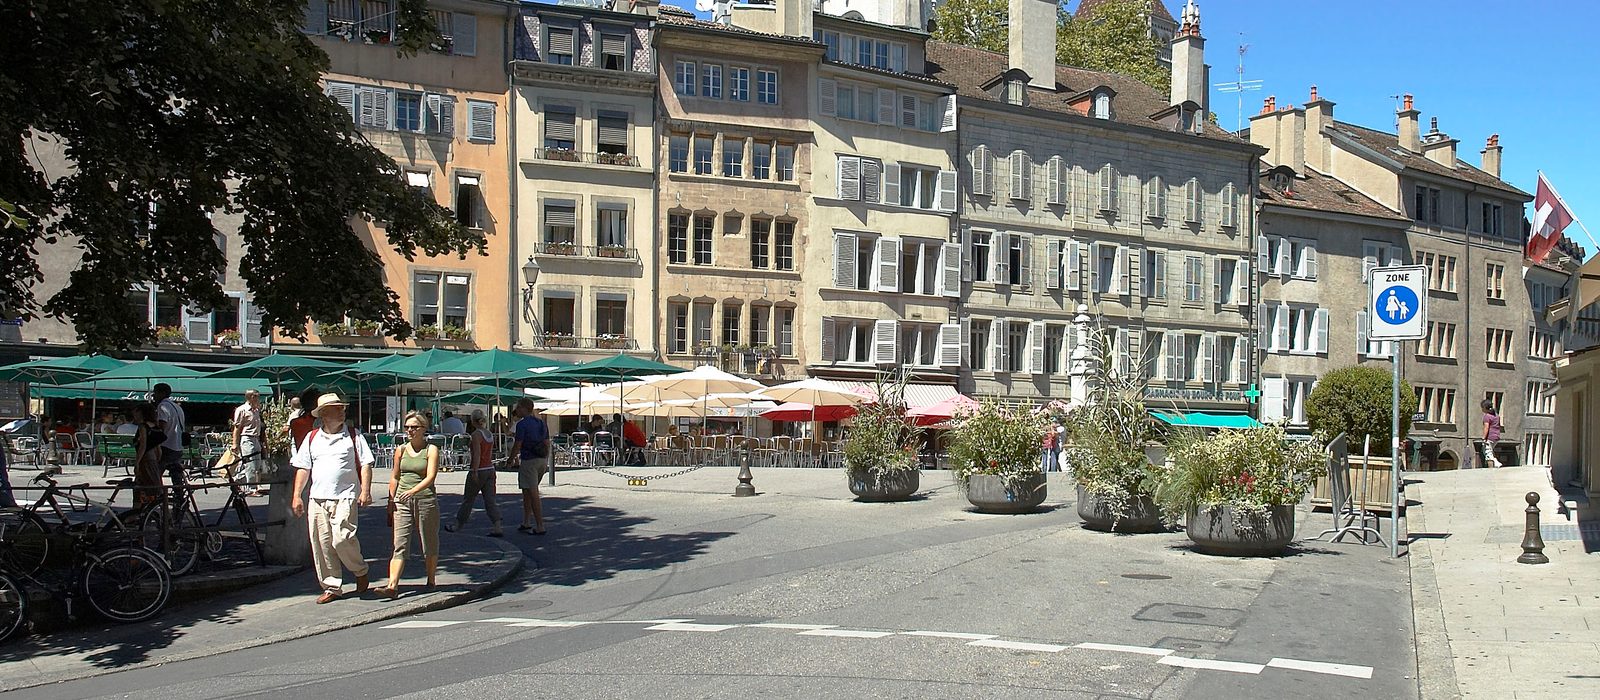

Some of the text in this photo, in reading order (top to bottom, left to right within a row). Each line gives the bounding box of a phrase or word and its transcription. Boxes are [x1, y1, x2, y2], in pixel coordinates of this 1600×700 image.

[1385, 273, 1410, 282] ZONE
[121, 391, 189, 402] La Cence
